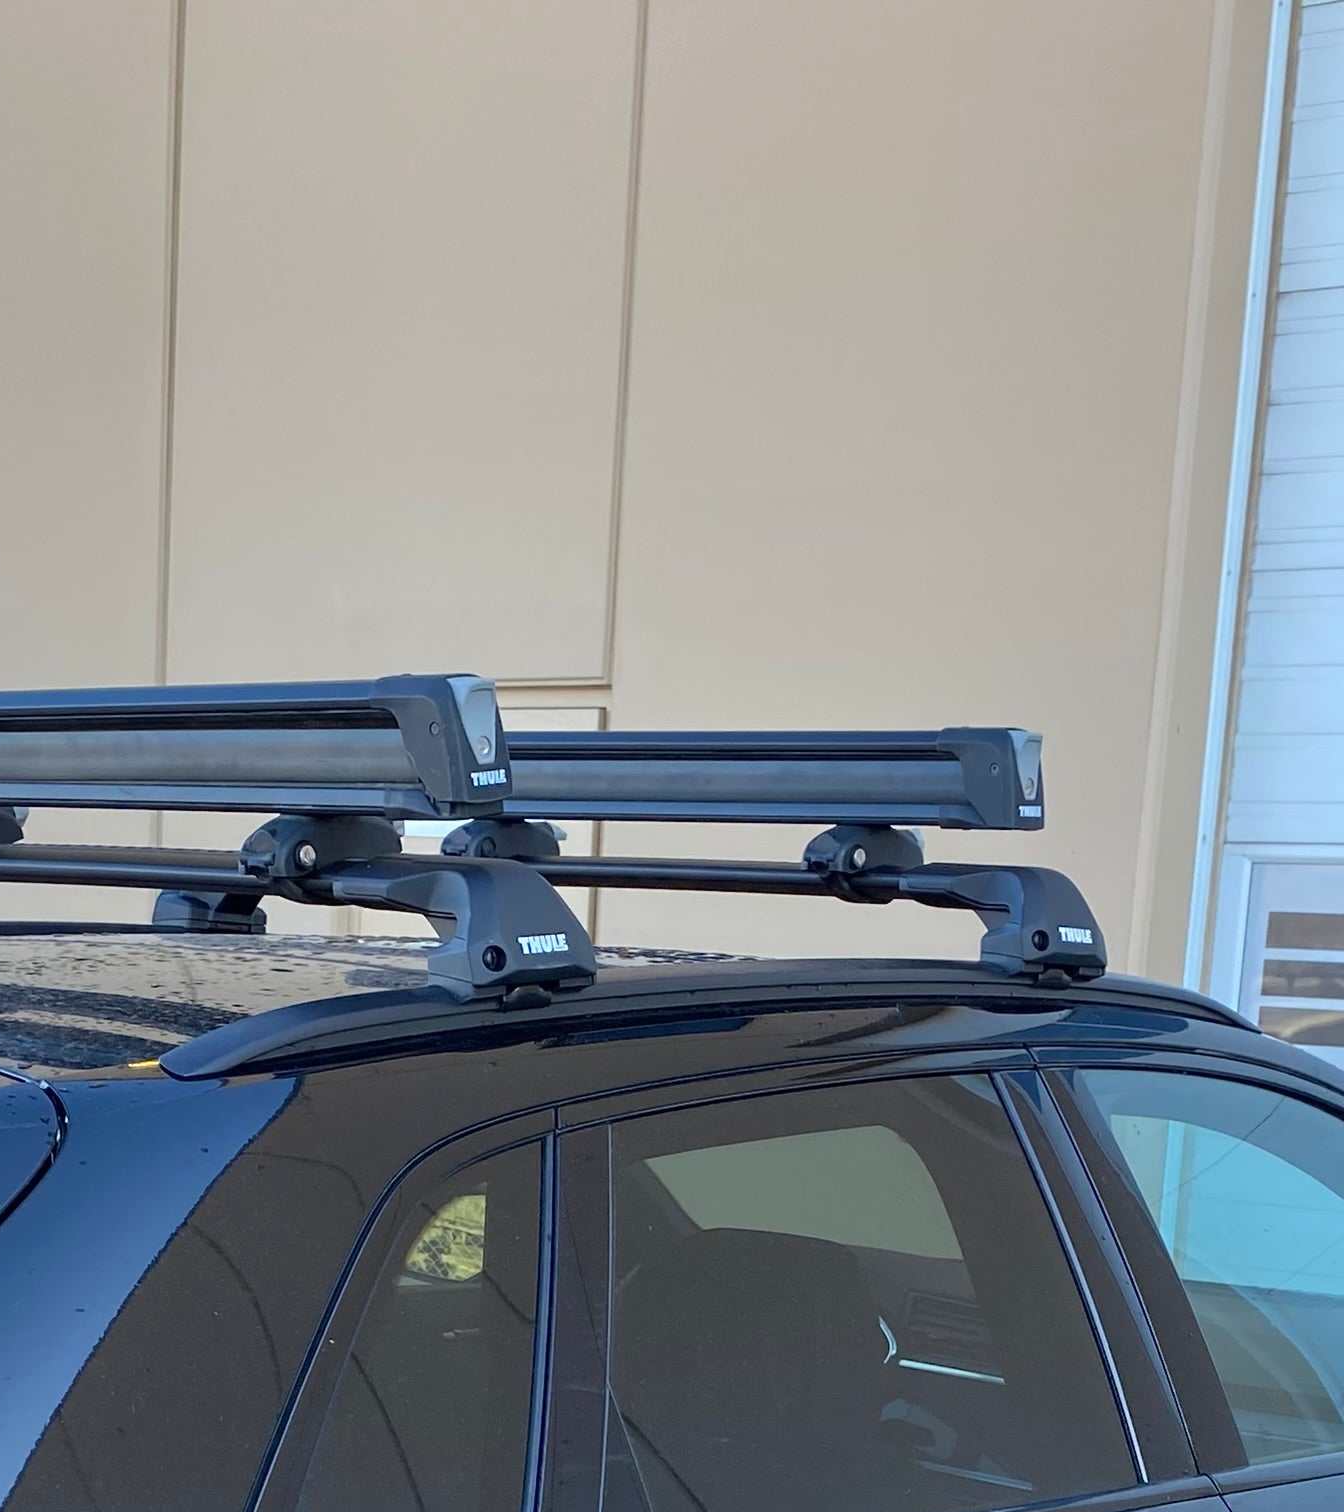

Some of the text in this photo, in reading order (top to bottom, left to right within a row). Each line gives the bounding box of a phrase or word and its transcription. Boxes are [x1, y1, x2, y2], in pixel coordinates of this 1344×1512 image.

[470, 769, 507, 786] THULE
[517, 933, 569, 955] THULE
[1058, 926, 1093, 944] THULE
